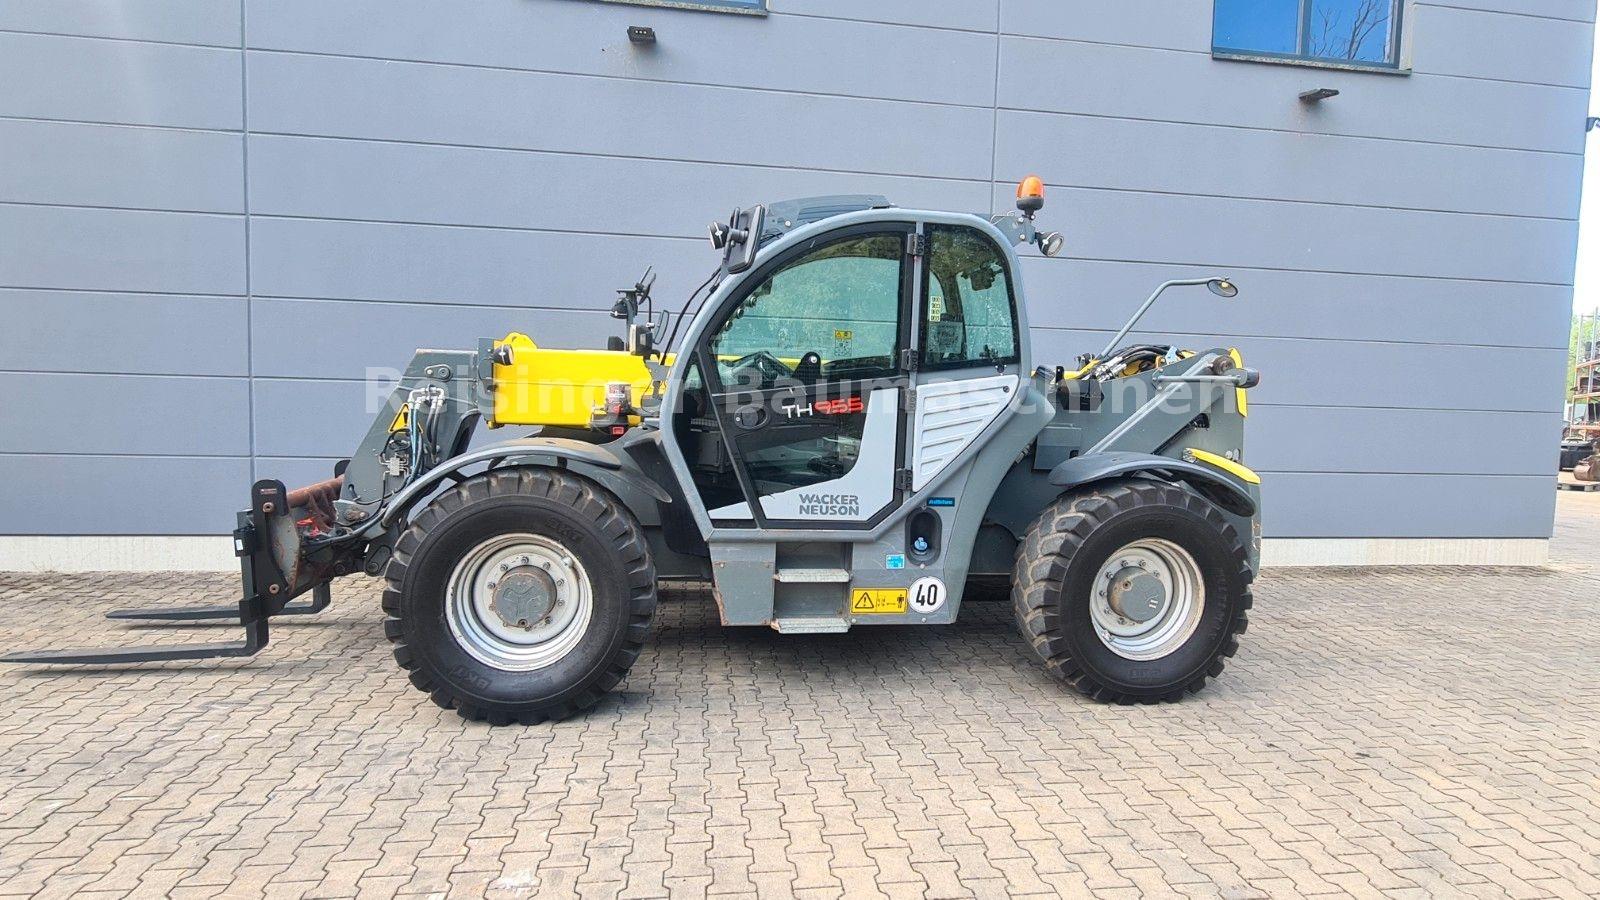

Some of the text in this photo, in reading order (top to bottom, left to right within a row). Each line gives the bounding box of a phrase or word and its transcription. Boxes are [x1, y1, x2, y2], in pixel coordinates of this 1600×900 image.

[781, 397, 864, 419] TH955
[799, 494, 859, 505] WACKER
[799, 505, 860, 516] NEUSON
[916, 584, 938, 606] 40
